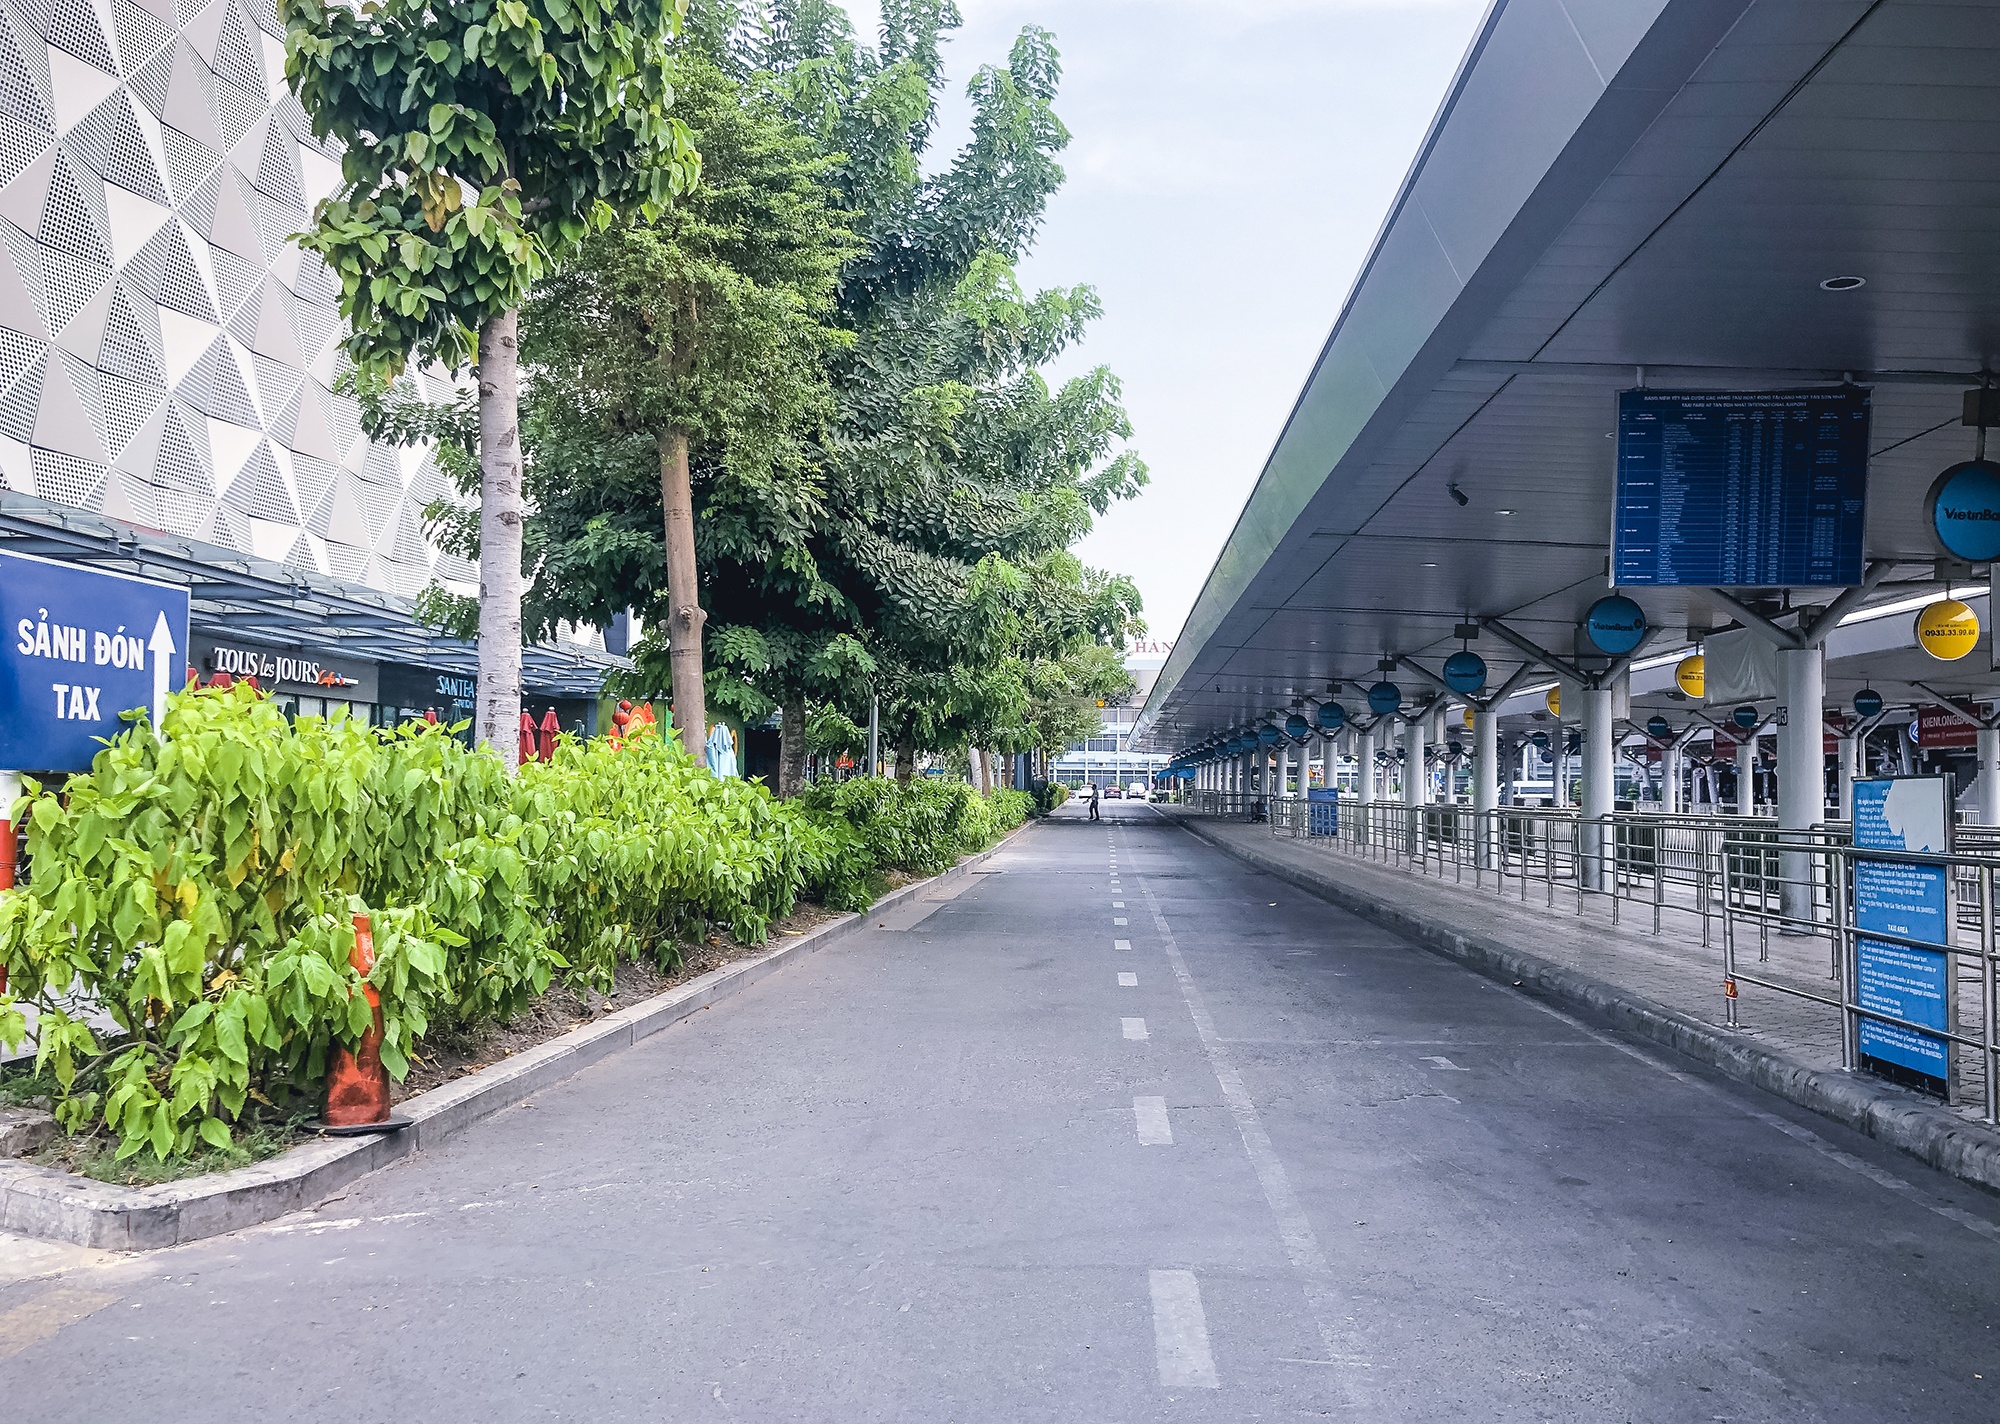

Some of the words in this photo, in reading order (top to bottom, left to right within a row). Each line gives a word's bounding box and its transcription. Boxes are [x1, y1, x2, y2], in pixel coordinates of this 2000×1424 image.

[17, 607, 86, 663] SẢNH
[93, 626, 145, 671] ĐÓN
[214, 647, 258, 676] TOUS
[259, 654, 275, 678] les
[274, 656, 320, 684] JOURS
[52, 683, 101, 722] TAX
[436, 675, 474, 698] SANTEA
